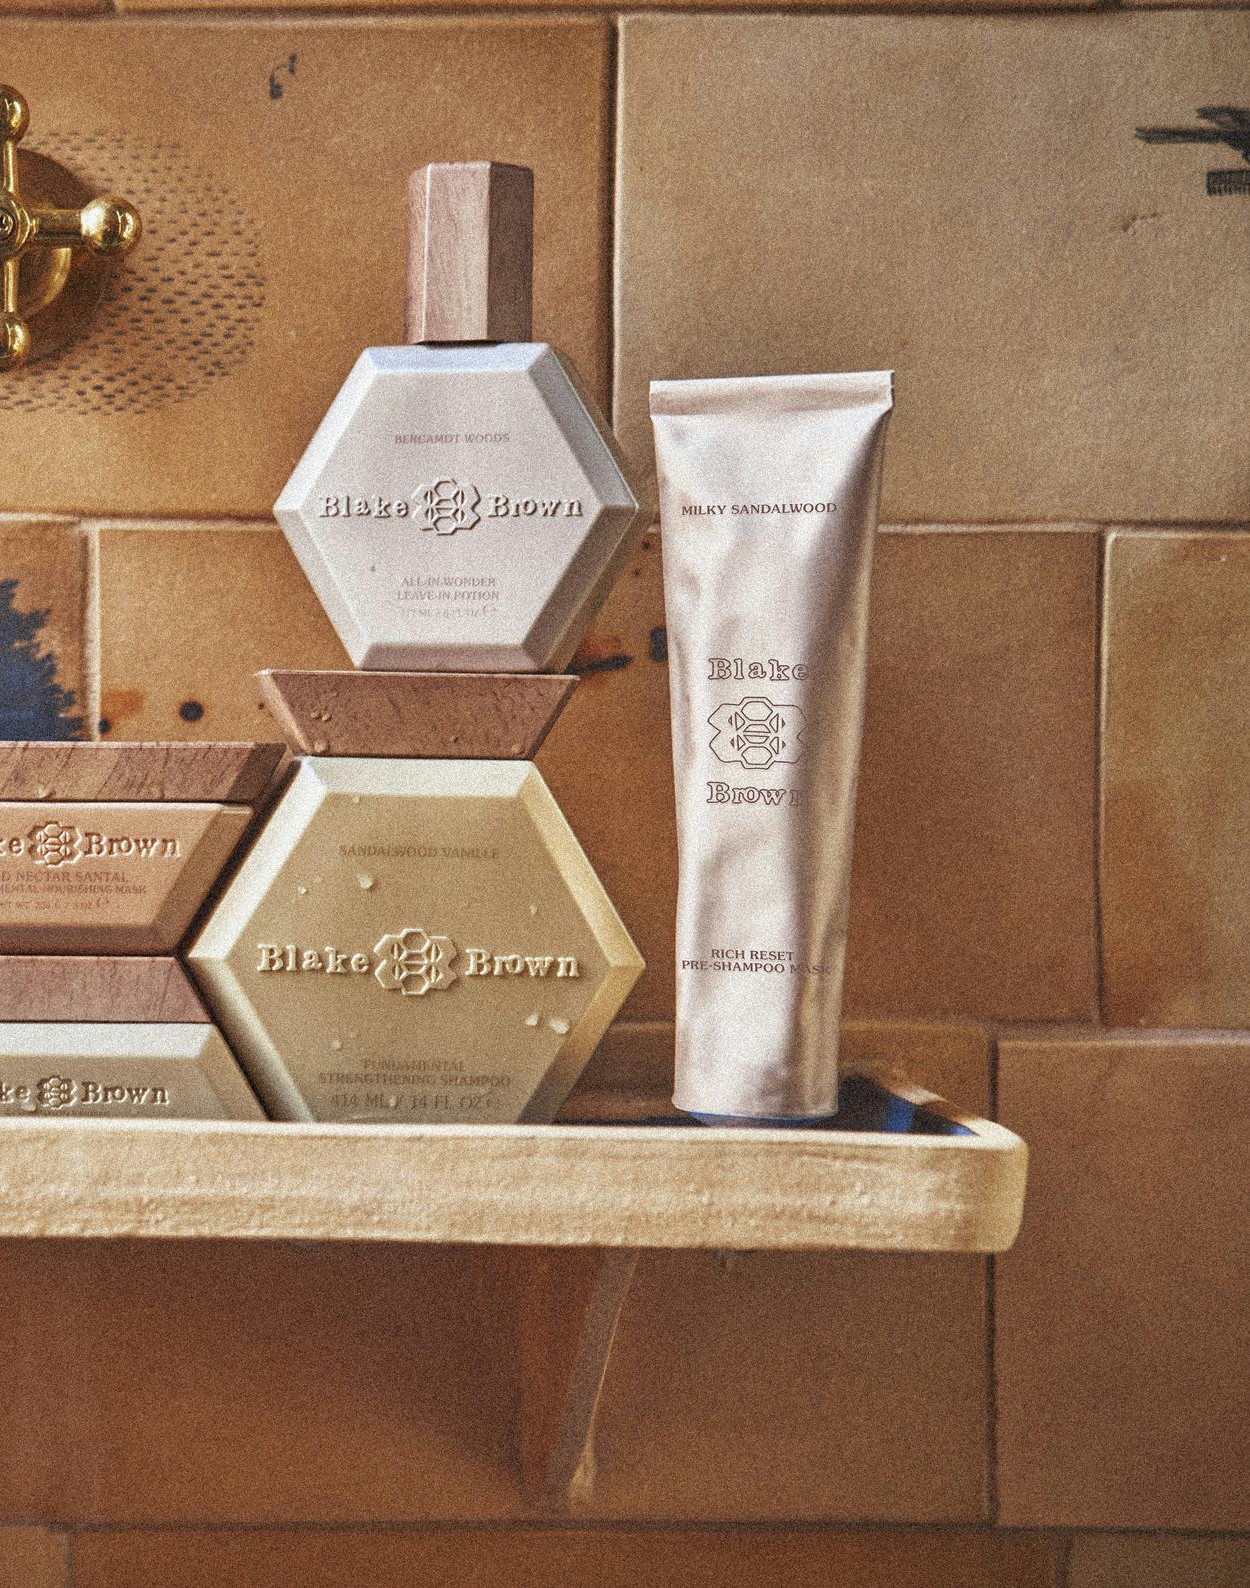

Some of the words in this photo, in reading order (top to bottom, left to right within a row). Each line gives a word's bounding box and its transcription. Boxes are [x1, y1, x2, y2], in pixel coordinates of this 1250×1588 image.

[394, 433, 460, 445] BERGAMOT
[464, 432, 510, 444] WOODS
[318, 494, 409, 519] Blake
[487, 494, 583, 519] Brown
[681, 504, 727, 516] MILKY
[731, 502, 837, 515] SANDALWOOD
[397, 590, 450, 601] LEAVE-IN
[454, 590, 500, 601] POTION
[707, 657, 809, 681] Blake
[83, 831, 181, 859] Brown
[338, 844, 438, 857] SANDALWOOD
[16, 870, 71, 882] NECTAR
[75, 871, 128, 883] SANTAL
[256, 943, 370, 973] Blake
[465, 947, 580, 977] Brown
[710, 949, 745, 960] RICH
[750, 950, 795, 961] RESET
[681, 960, 785, 974] PRE-SHAMPOO
[440, 1074, 511, 1087] SHAMPOO
[80, 1080, 170, 1105] Brown
[364, 1092, 389, 1109] ML
